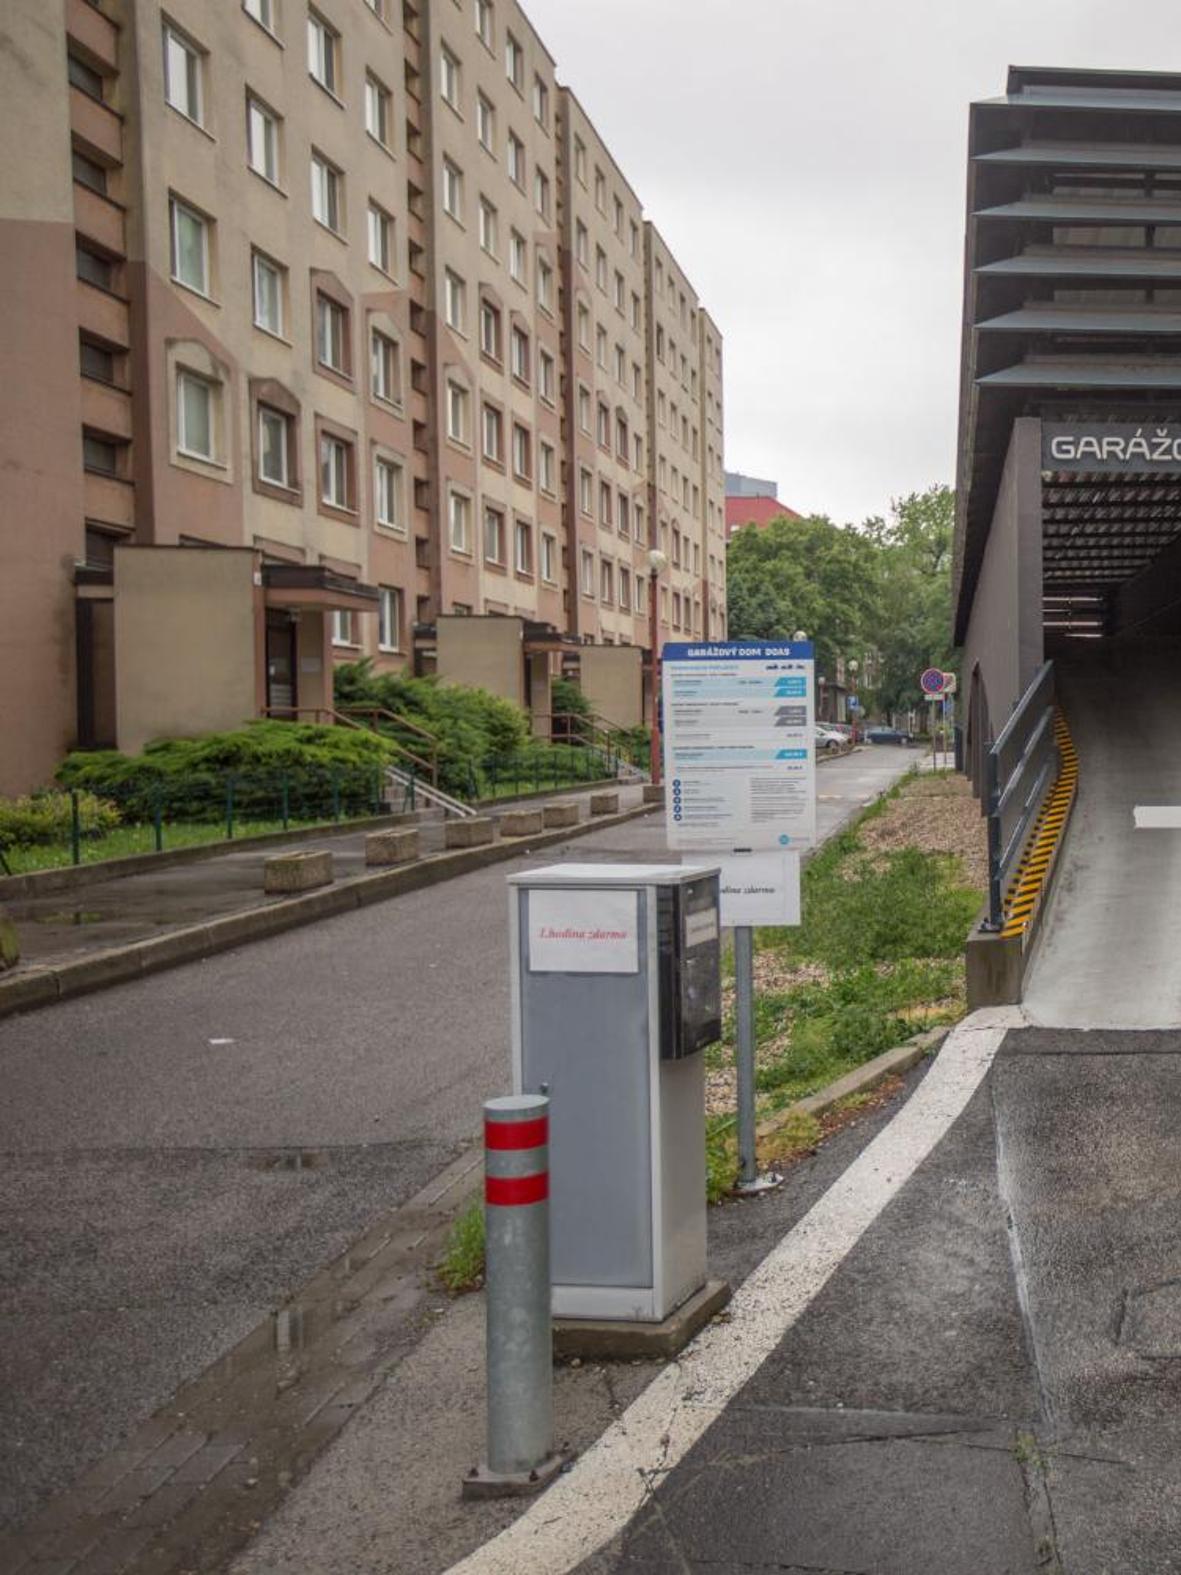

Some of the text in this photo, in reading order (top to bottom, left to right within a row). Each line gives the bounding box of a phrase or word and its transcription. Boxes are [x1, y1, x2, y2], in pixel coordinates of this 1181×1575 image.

[687, 646, 791, 657] GARÁŽOVÝ DOM DOAS
